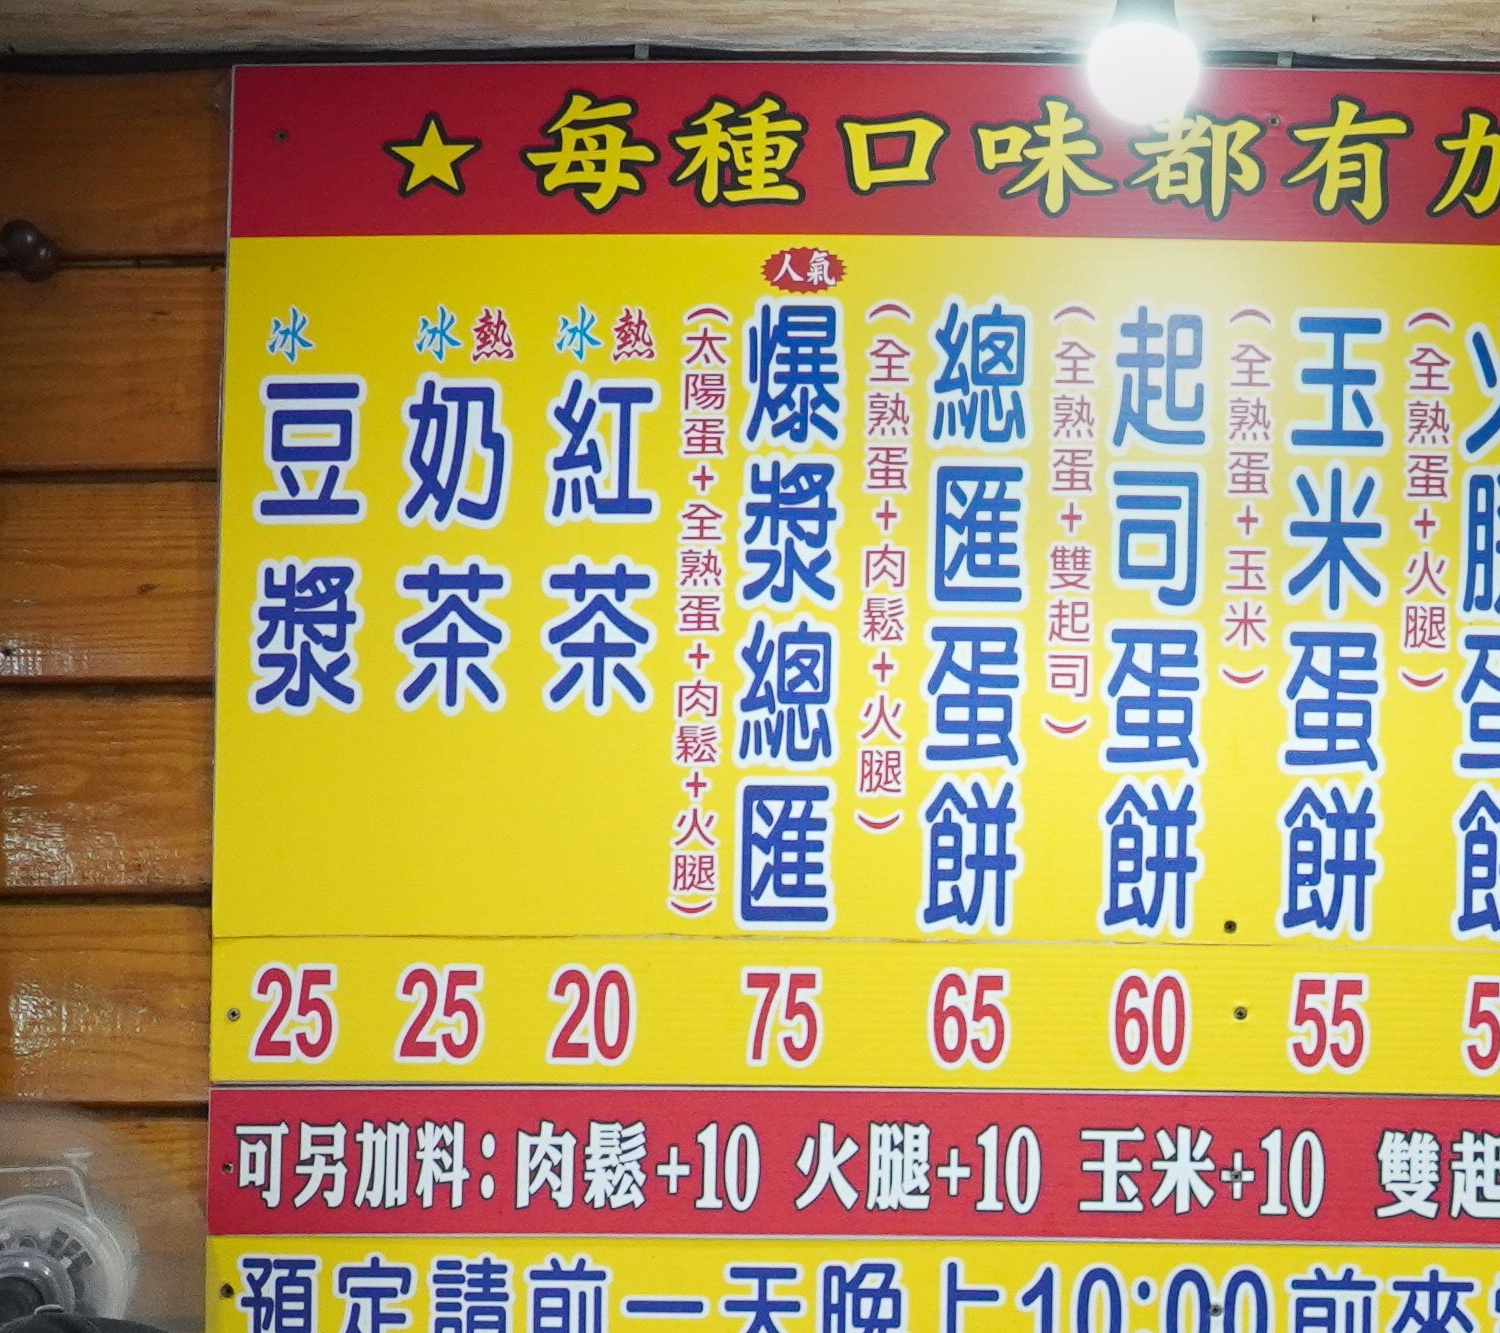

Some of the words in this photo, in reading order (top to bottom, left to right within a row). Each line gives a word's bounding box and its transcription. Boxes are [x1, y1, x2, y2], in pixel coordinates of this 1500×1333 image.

[270, 306, 314, 362] 冰
[774, 252, 837, 288] 人氣
[254, 380, 362, 710] 豆漿
[400, 376, 508, 710] 奶茶
[547, 376, 656, 710] 紅茶
[738, 303, 842, 923] 爆漿總匯
[923, 303, 1027, 927] 總匯蛋餅
[1103, 305, 1207, 929] 起司蛋餅
[1282, 315, 1385, 934] 玉米蛋餅
[254, 968, 335, 1060] 25
[399, 969, 481, 1060] 25
[548, 969, 631, 1061] 20
[744, 971, 819, 1063] 75
[933, 973, 1007, 1065] 65
[1114, 974, 1186, 1067] 60
[1291, 977, 1366, 1069] 55
[794, 1122, 1042, 1216] 火腿+10
[1079, 1125, 1327, 1219] 玉米+10
